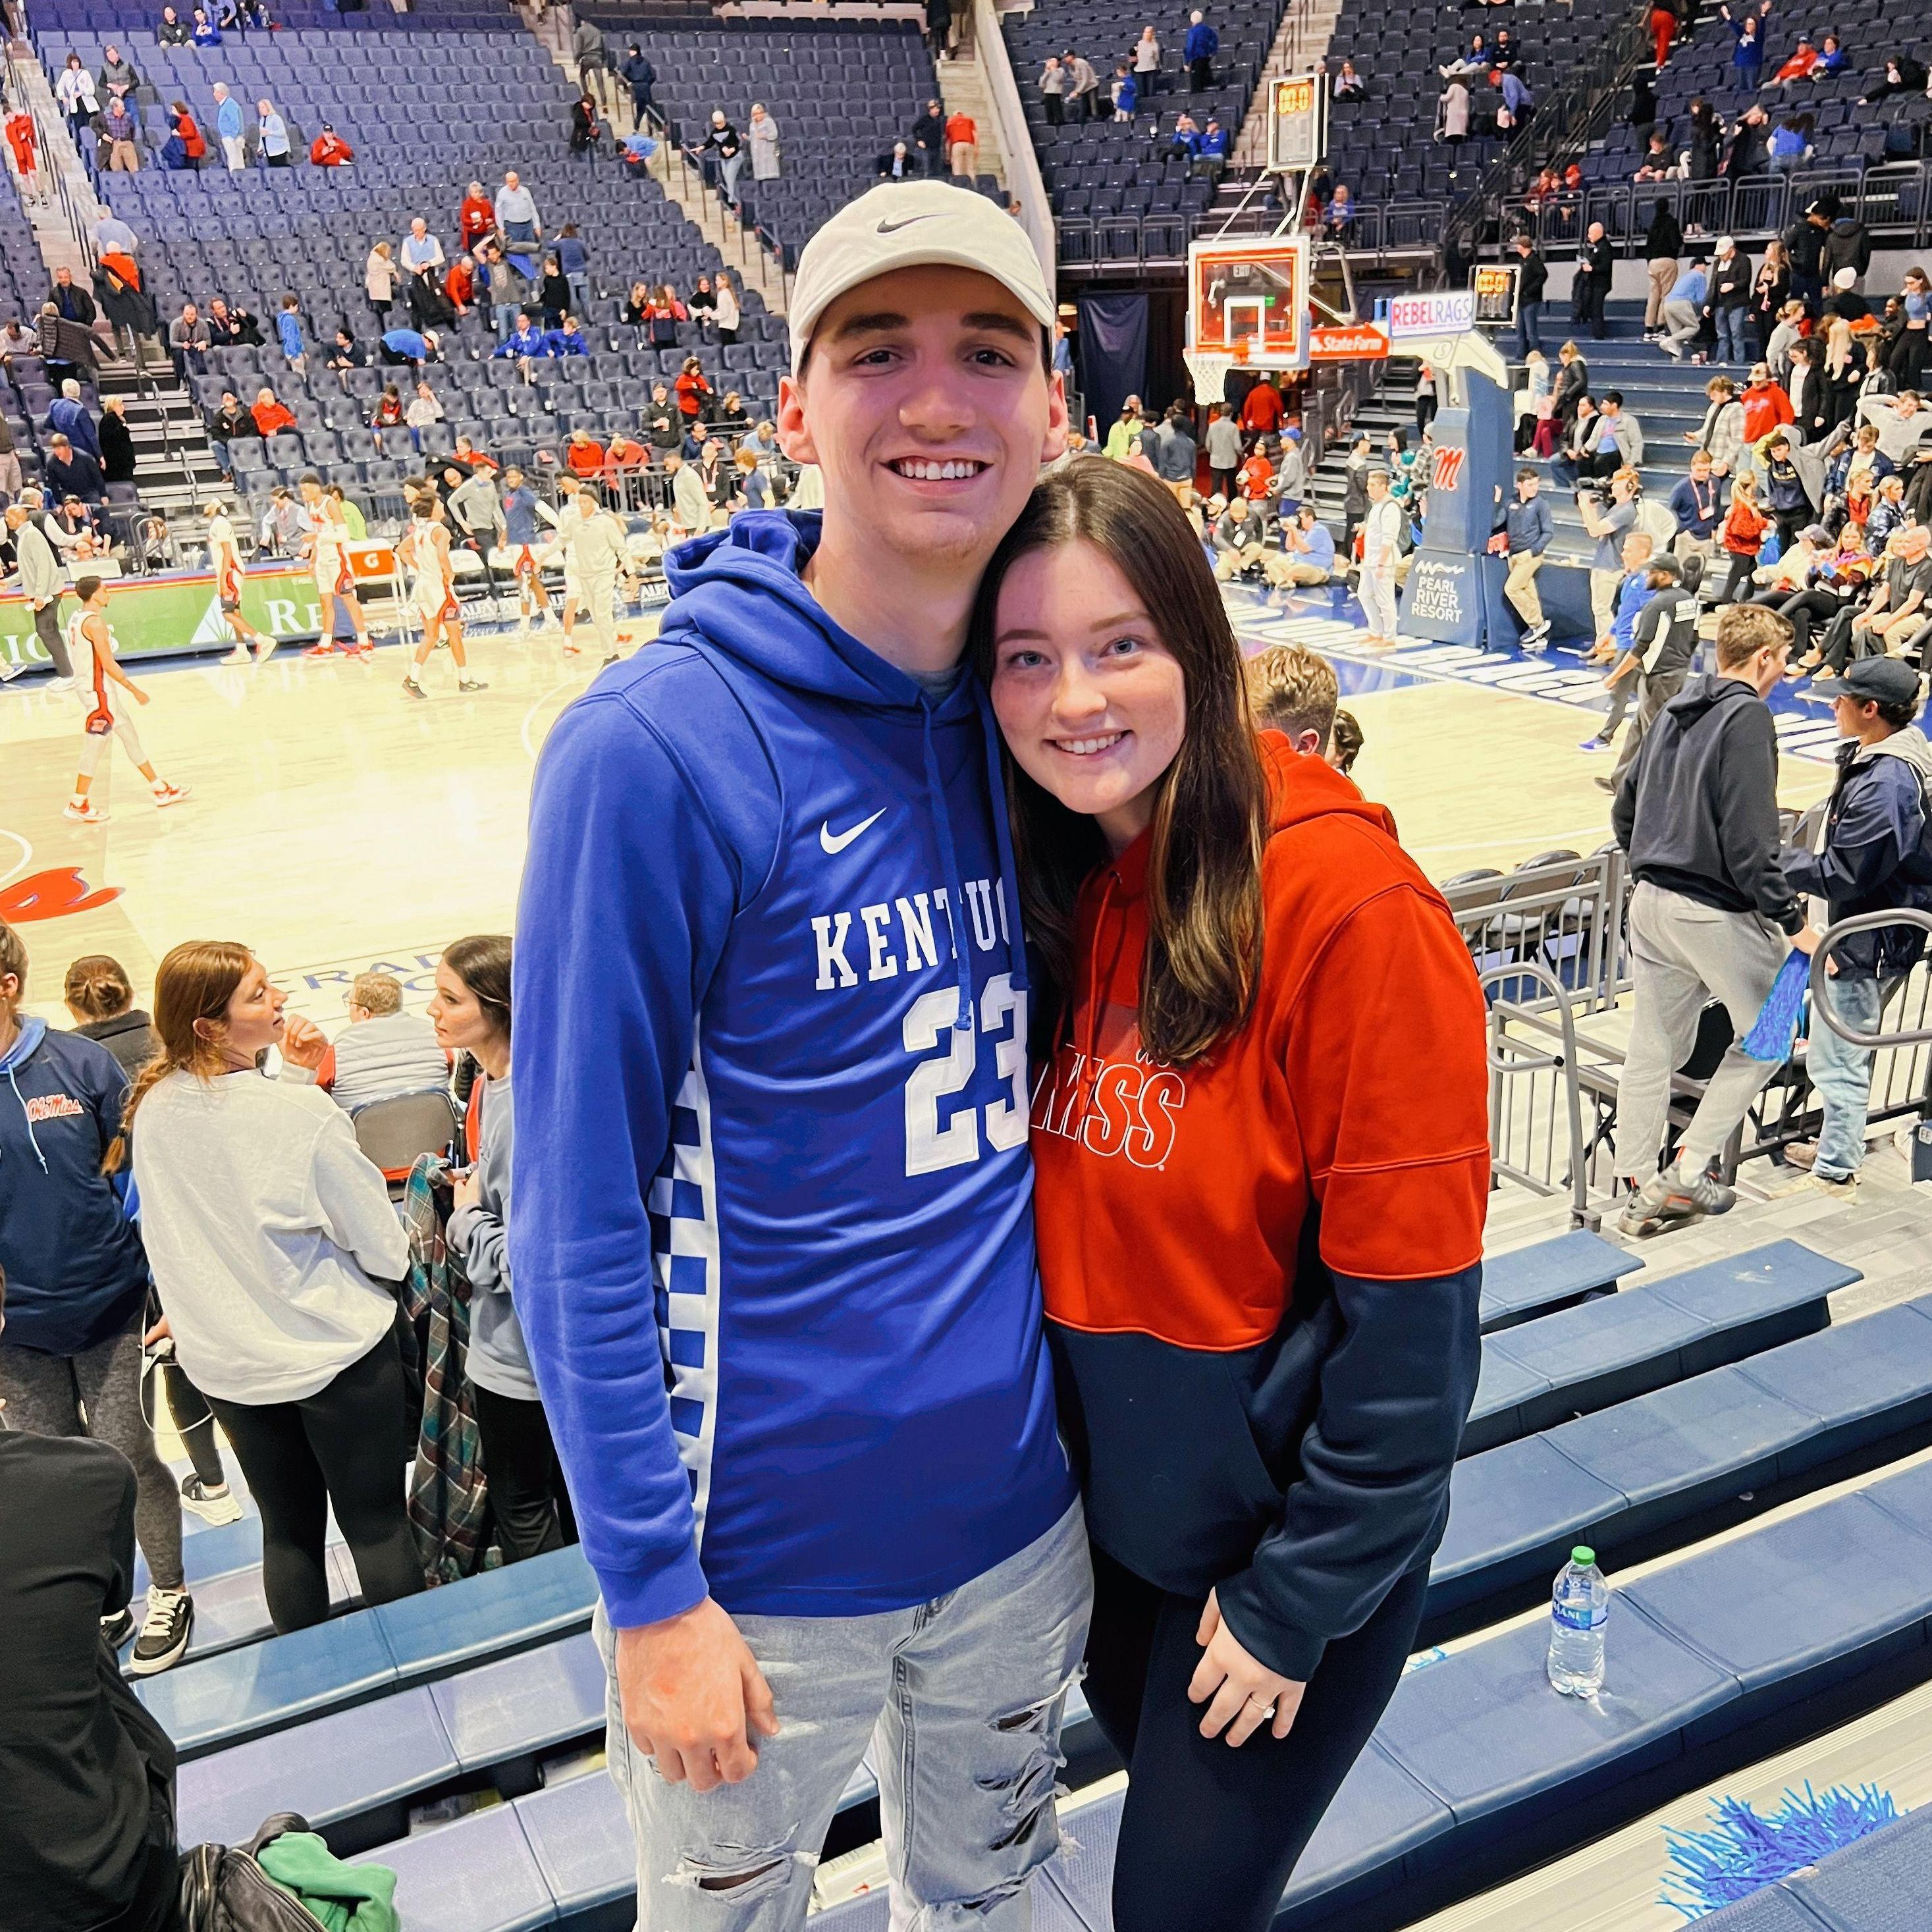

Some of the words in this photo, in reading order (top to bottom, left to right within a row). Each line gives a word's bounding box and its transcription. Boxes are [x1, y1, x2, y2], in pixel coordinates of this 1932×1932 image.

[364, 552, 379, 569] G
[1418, 576, 1457, 593] PEARL
[1416, 589, 1459, 610] RIVER
[1411, 603, 1462, 624] RESORT
[903, 973, 1029, 1177] 23
